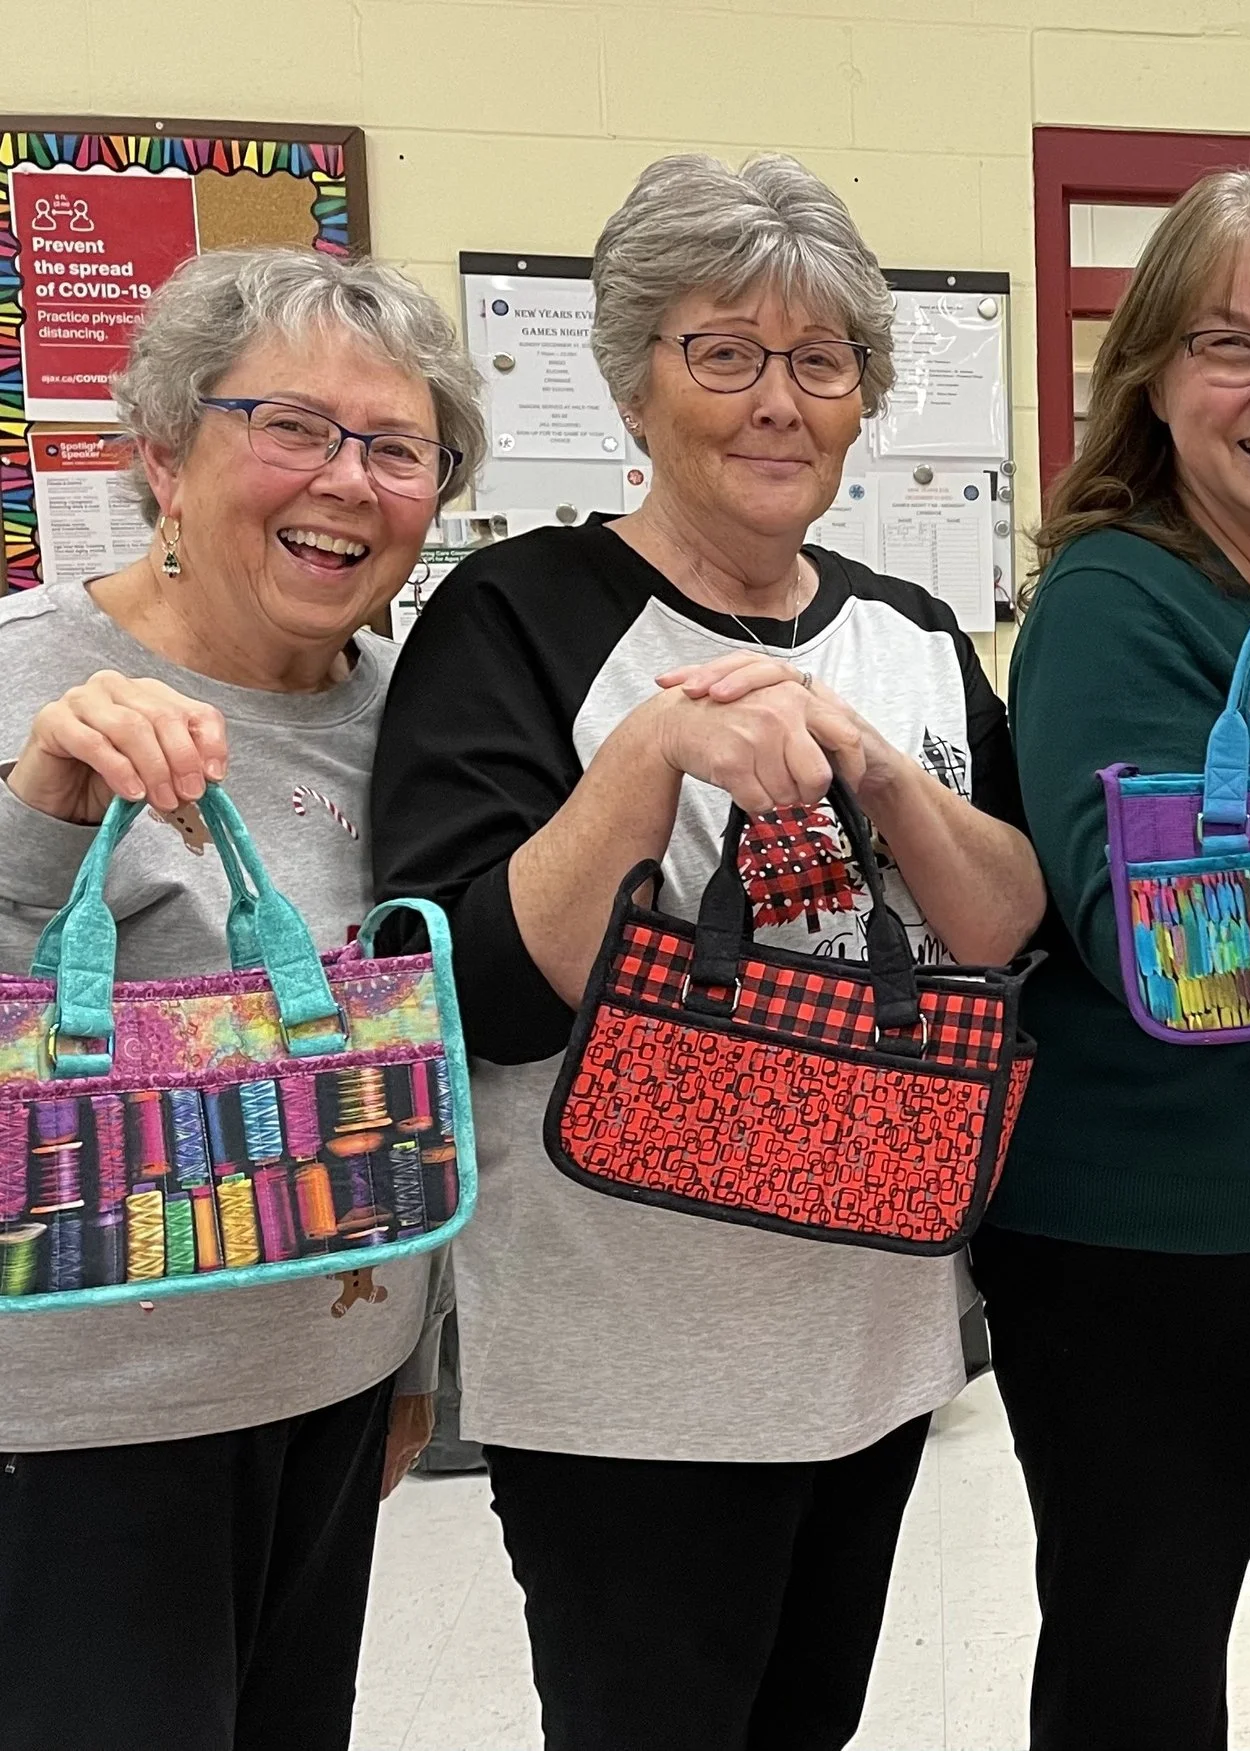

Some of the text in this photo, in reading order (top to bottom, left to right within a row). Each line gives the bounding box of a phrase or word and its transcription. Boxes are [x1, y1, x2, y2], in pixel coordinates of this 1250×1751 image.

[32, 236, 105, 254] Prevent
[34, 260, 134, 279] the spread
[36, 282, 151, 299] of COVID-19
[37, 310, 145, 326] Practice physical
[514, 309, 536, 319] NEW
[538, 309, 573, 319] YEARS
[39, 326, 108, 342] distancing.
[521, 328, 589, 337] GAMES NIGHT
